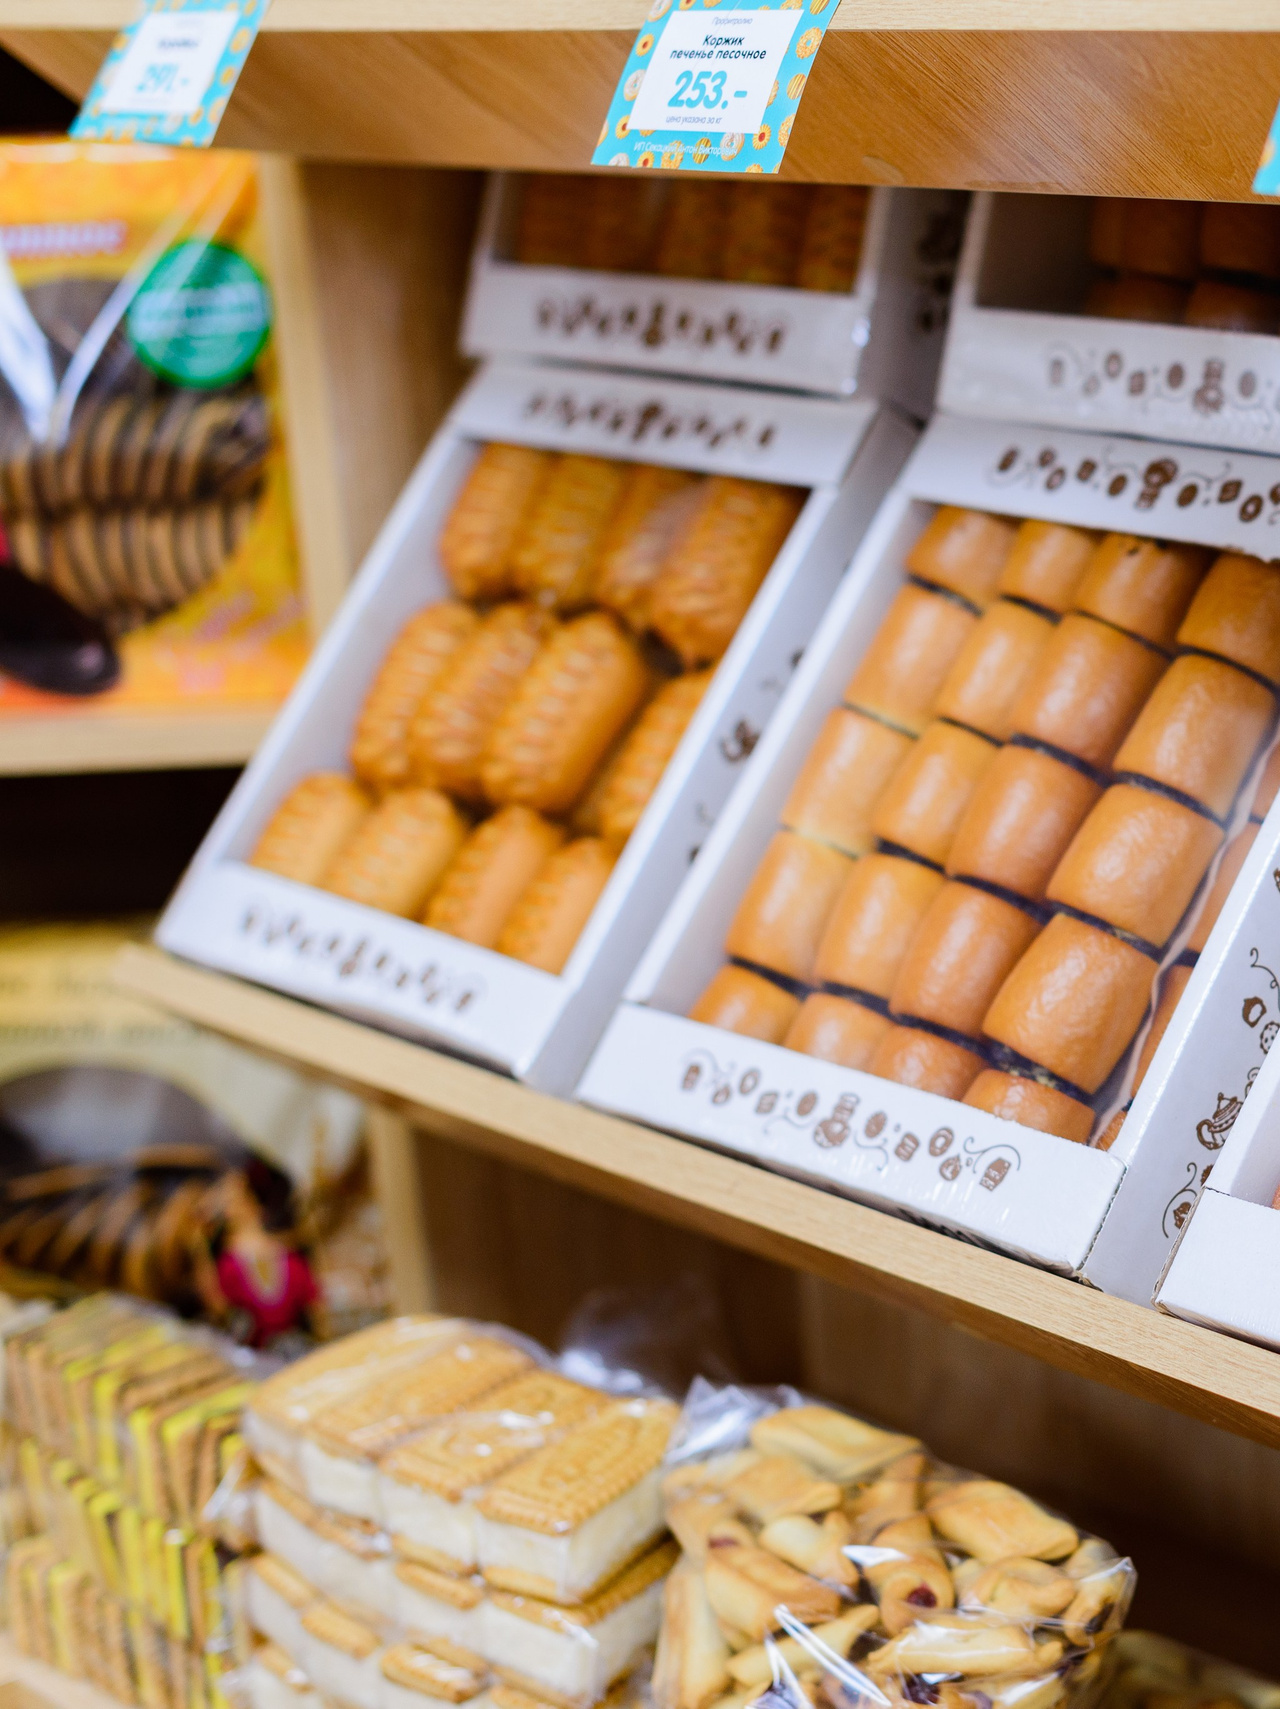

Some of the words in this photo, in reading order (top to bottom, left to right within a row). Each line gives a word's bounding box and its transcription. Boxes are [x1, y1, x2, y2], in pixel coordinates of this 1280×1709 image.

[702, 34, 745, 48] Коржик
[669, 49, 714, 60] печенье
[715, 49, 767, 60] песочное
[667, 69, 748, 110] 253.-
[665, 115, 682, 124] цена
[682, 116, 706, 125] указана
[706, 116, 715, 125] за
[715, 116, 723, 125] кг
[633, 141, 645, 152] ИП
